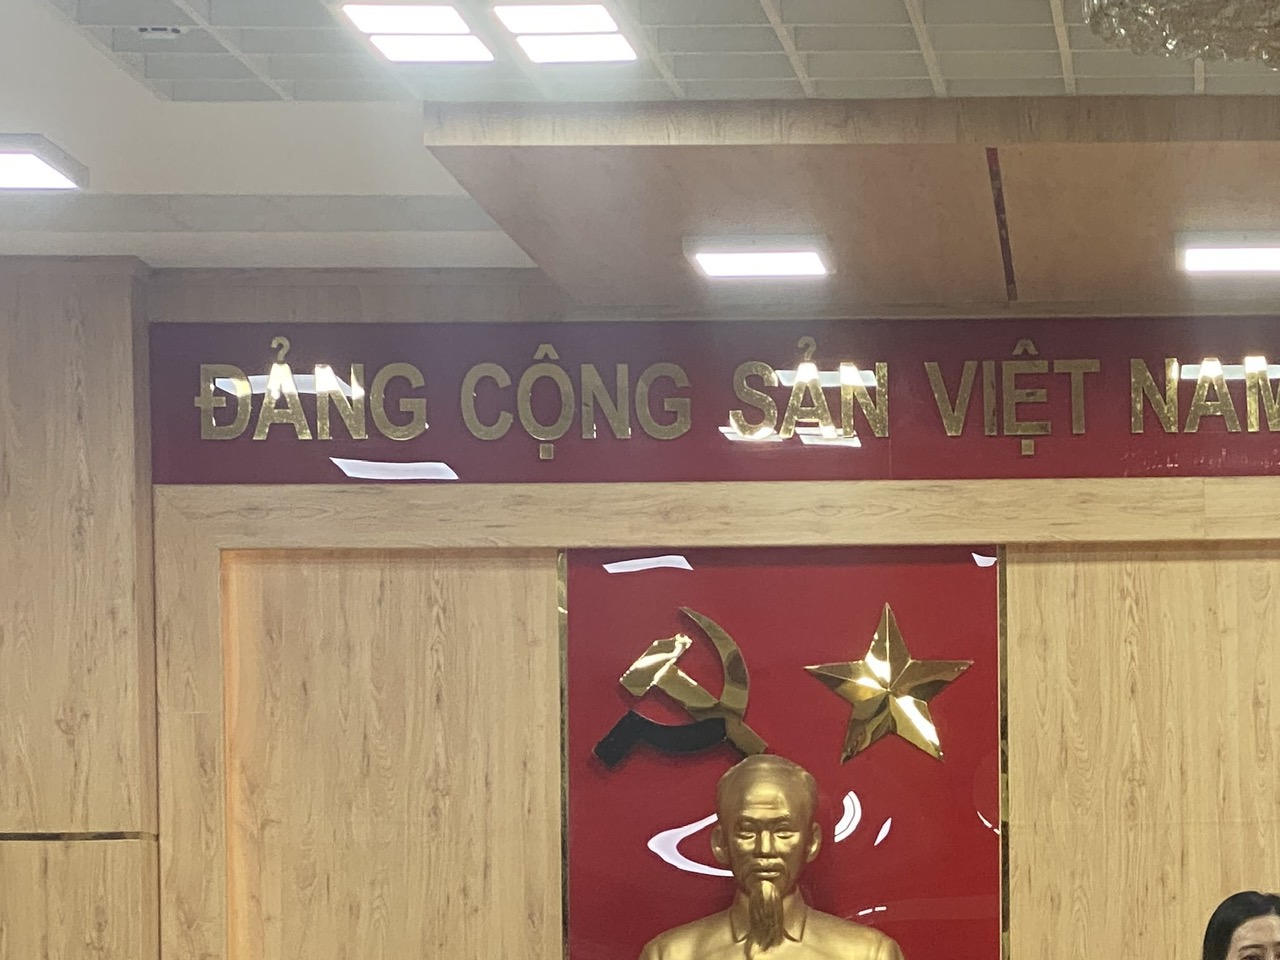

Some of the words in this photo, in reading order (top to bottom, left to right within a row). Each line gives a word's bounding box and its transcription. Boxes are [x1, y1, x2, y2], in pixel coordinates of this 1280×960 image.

[194, 338, 430, 441] ĐẢNG
[461, 345, 692, 460] CỘNG
[729, 338, 889, 441] SẢN
[925, 341, 1098, 456] VIỆT
